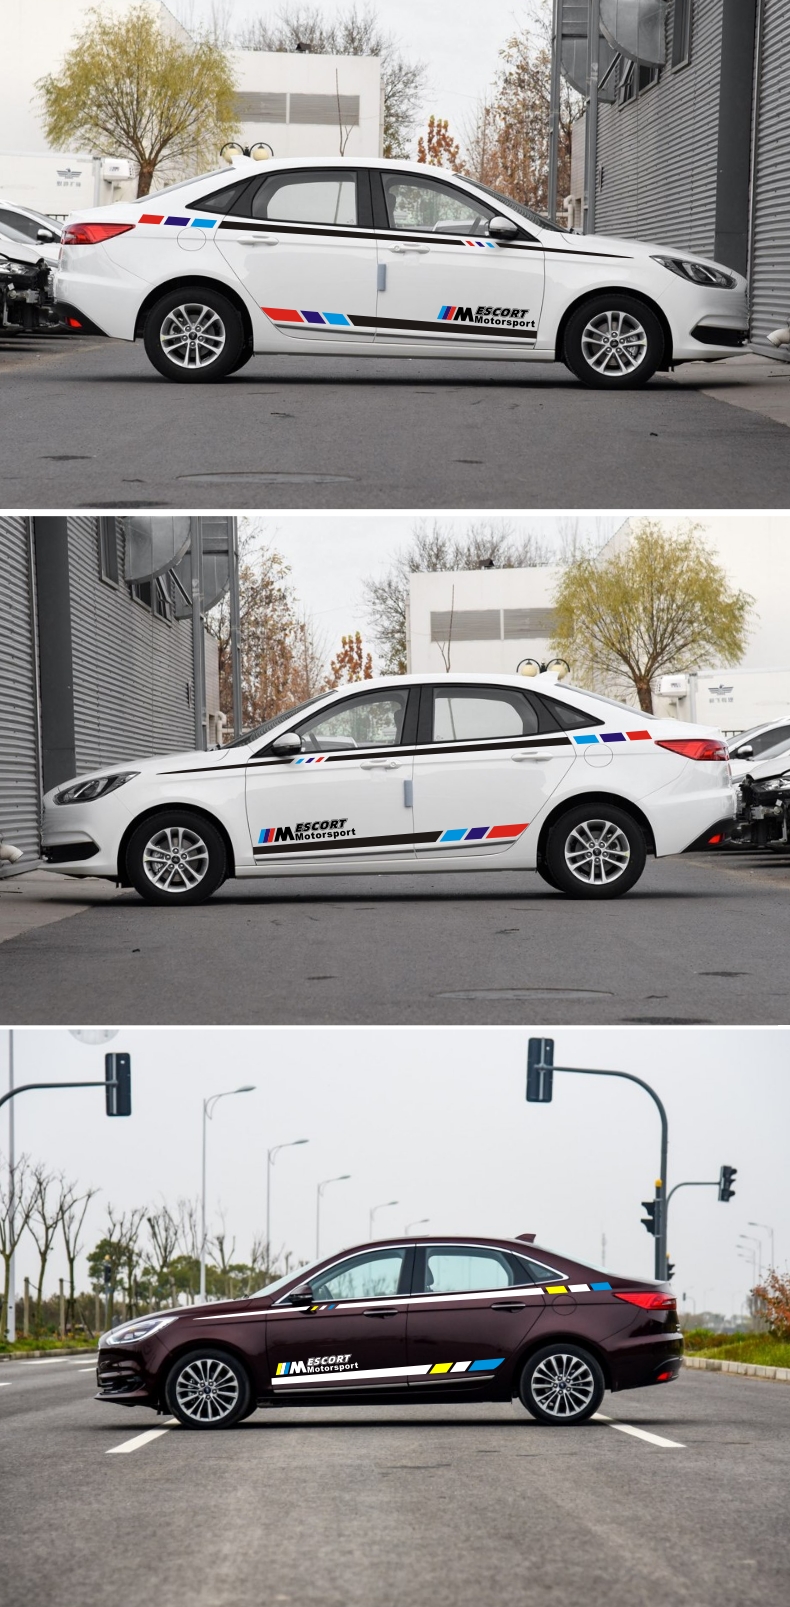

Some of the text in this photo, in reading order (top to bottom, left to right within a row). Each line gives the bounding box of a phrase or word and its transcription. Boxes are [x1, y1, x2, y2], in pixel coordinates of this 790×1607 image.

[453, 307, 474, 322] M
[475, 306, 530, 319] ESCORT
[474, 316, 535, 328] Motorsport
[295, 818, 348, 833] ESCORT
[274, 826, 295, 842] M
[295, 828, 356, 841] Motorsport
[307, 1354, 352, 1366] ESCORT
[289, 1361, 307, 1375] M
[307, 1362, 359, 1373] Motorsport
